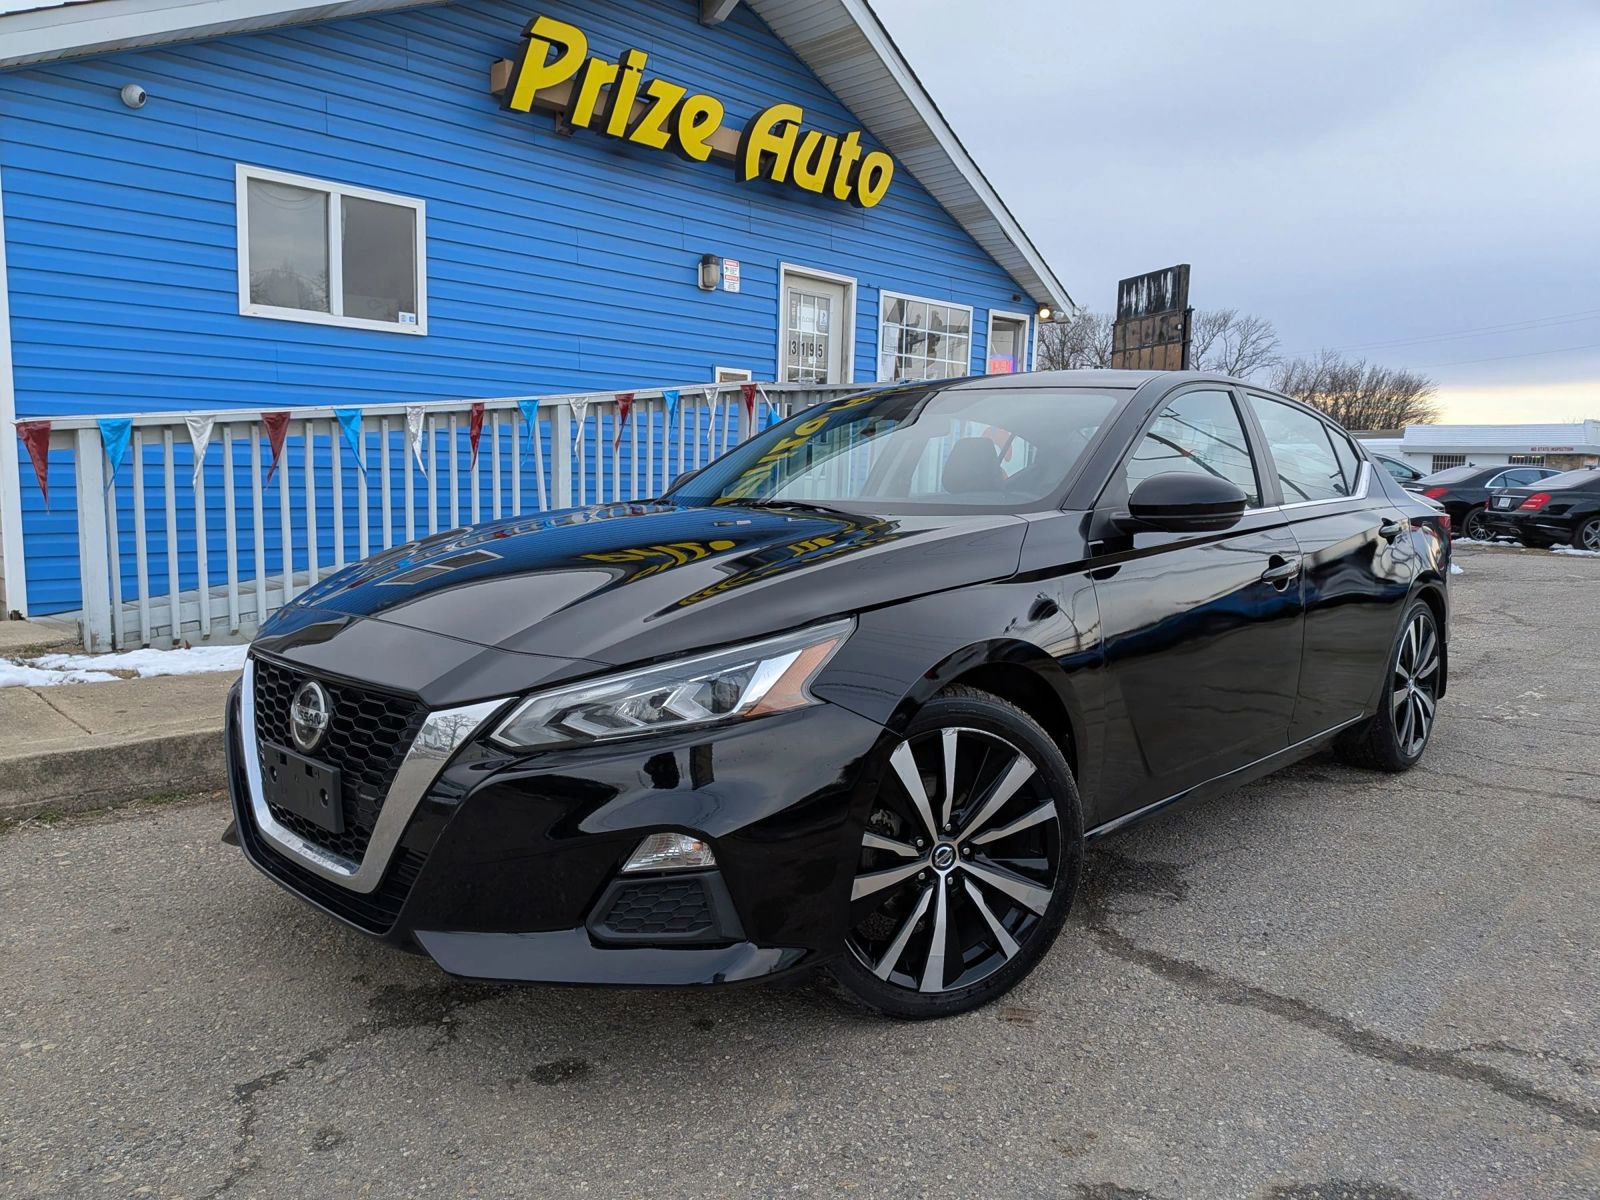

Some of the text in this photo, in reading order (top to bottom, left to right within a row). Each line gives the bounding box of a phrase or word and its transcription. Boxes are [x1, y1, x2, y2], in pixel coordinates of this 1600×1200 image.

[509, 15, 895, 208] Prize Auto
[791, 341, 823, 358] 3195
[292, 707, 321, 725] SSAN
